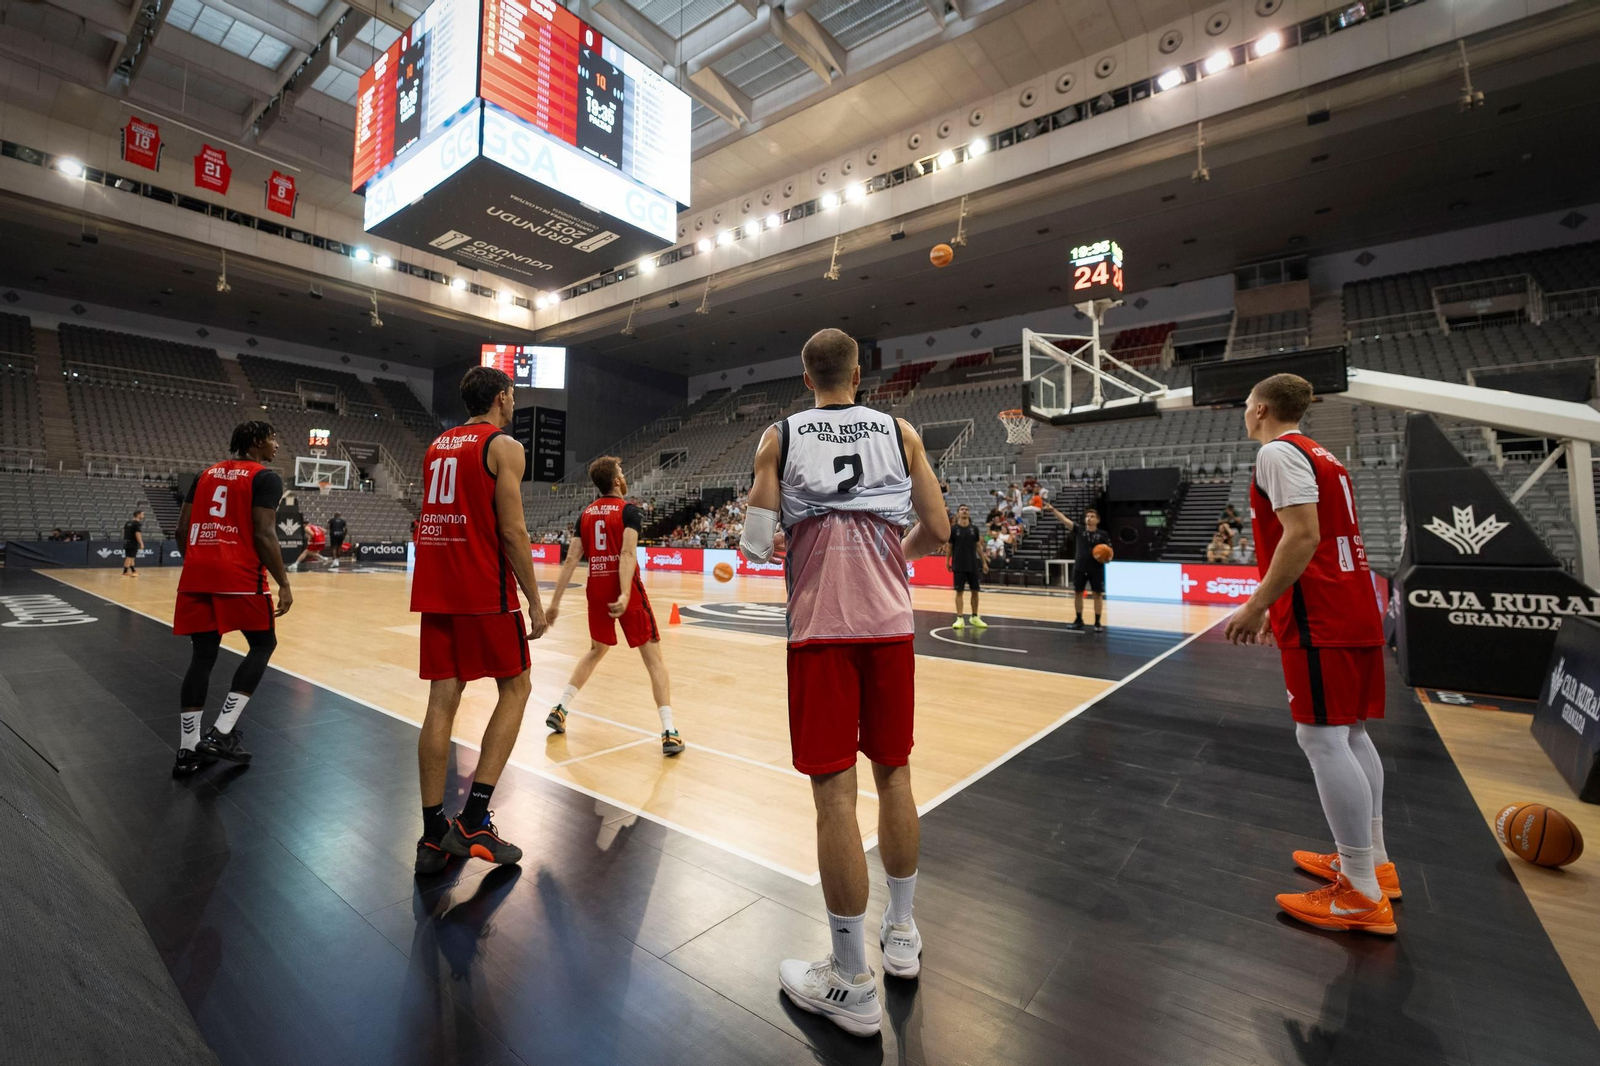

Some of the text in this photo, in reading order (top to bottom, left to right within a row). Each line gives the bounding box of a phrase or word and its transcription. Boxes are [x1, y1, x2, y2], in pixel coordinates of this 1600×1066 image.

[135, 133, 150, 149] 18
[205, 161, 220, 178] 21
[278, 186, 286, 198] 8
[543, 219, 588, 239] 2031
[462, 245, 504, 261] 2031
[1074, 262, 1109, 290] 24
[798, 421, 889, 435] CAJA RURAL
[817, 431, 870, 443] GRANADA
[428, 457, 457, 504] 10
[833, 453, 863, 493] 2
[209, 485, 228, 518] 9
[200, 531, 217, 539] 2031
[421, 525, 442, 536] 2031
[595, 519, 607, 551] 6
[360, 545, 404, 554] endesa
[1408, 589, 1485, 611] CAJA
[1448, 611, 1562, 631] GRANADA
[1561, 673, 1578, 703] CAJA
[1561, 702, 1586, 736] GRANADA
